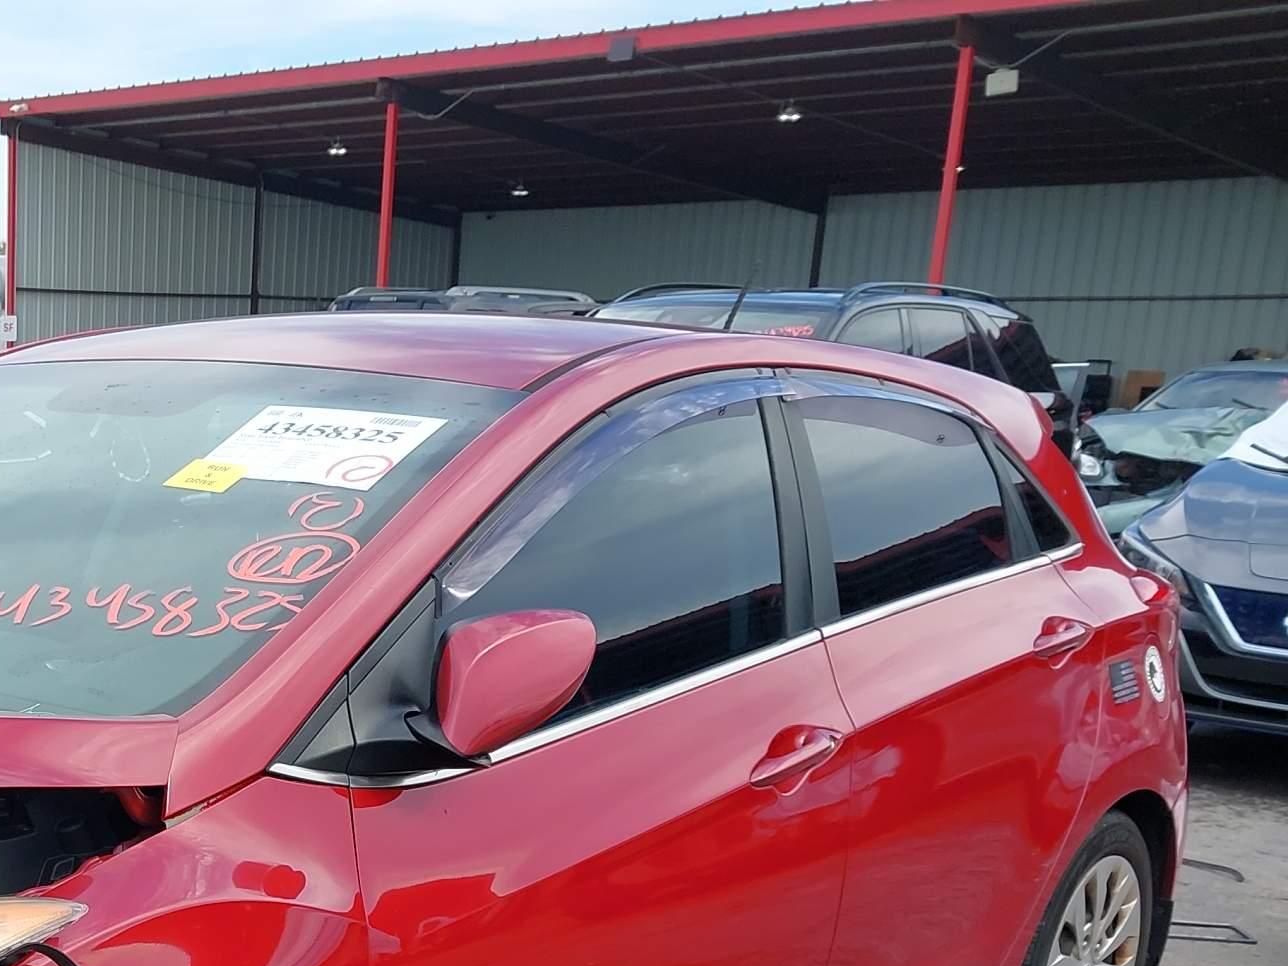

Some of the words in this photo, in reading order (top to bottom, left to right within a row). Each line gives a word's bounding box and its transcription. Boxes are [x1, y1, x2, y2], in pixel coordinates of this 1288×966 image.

[3, 322, 15, 333] SF
[256, 421, 405, 444] 43458325
[208, 464, 231, 472] RUN
